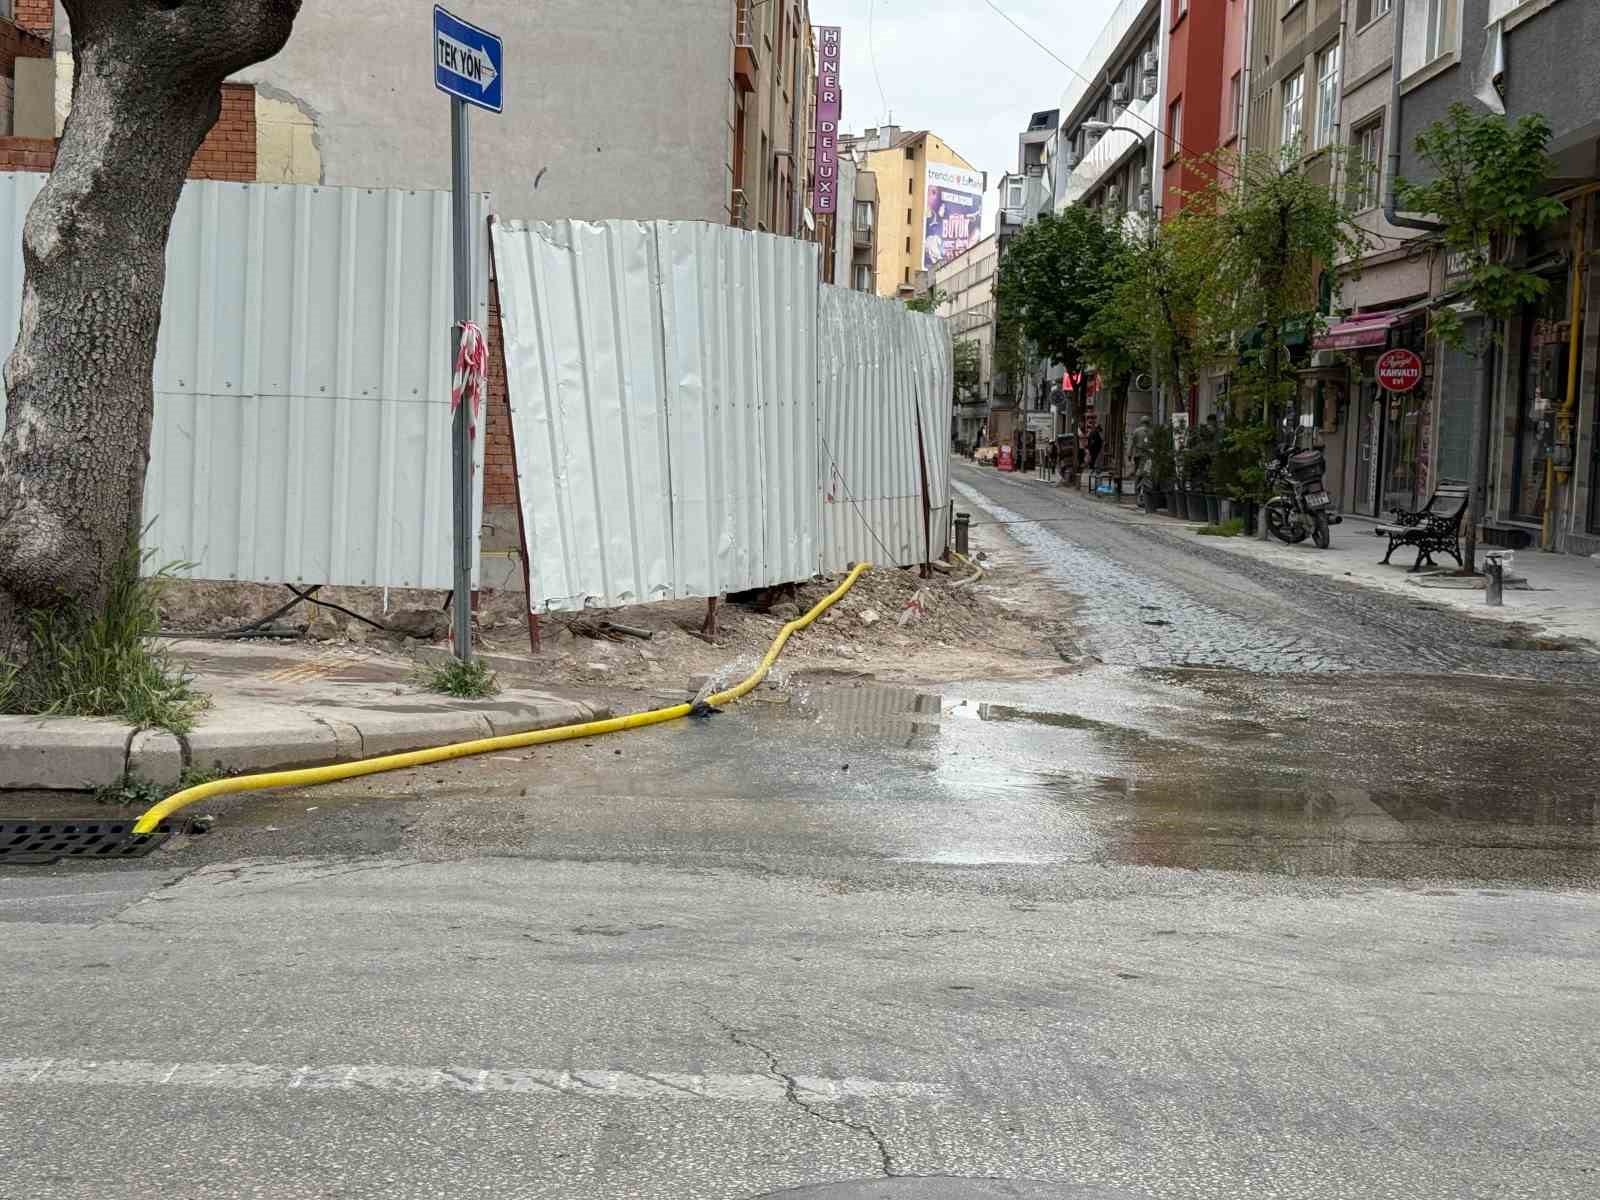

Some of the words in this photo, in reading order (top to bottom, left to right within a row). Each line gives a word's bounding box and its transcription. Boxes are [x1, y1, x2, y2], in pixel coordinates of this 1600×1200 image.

[439, 38, 458, 71] TEK
[460, 48, 481, 81] YÖN
[823, 30, 839, 103] HÜNER
[820, 121, 835, 208] DELUXE
[1380, 367, 1418, 377] KAHVALTI
